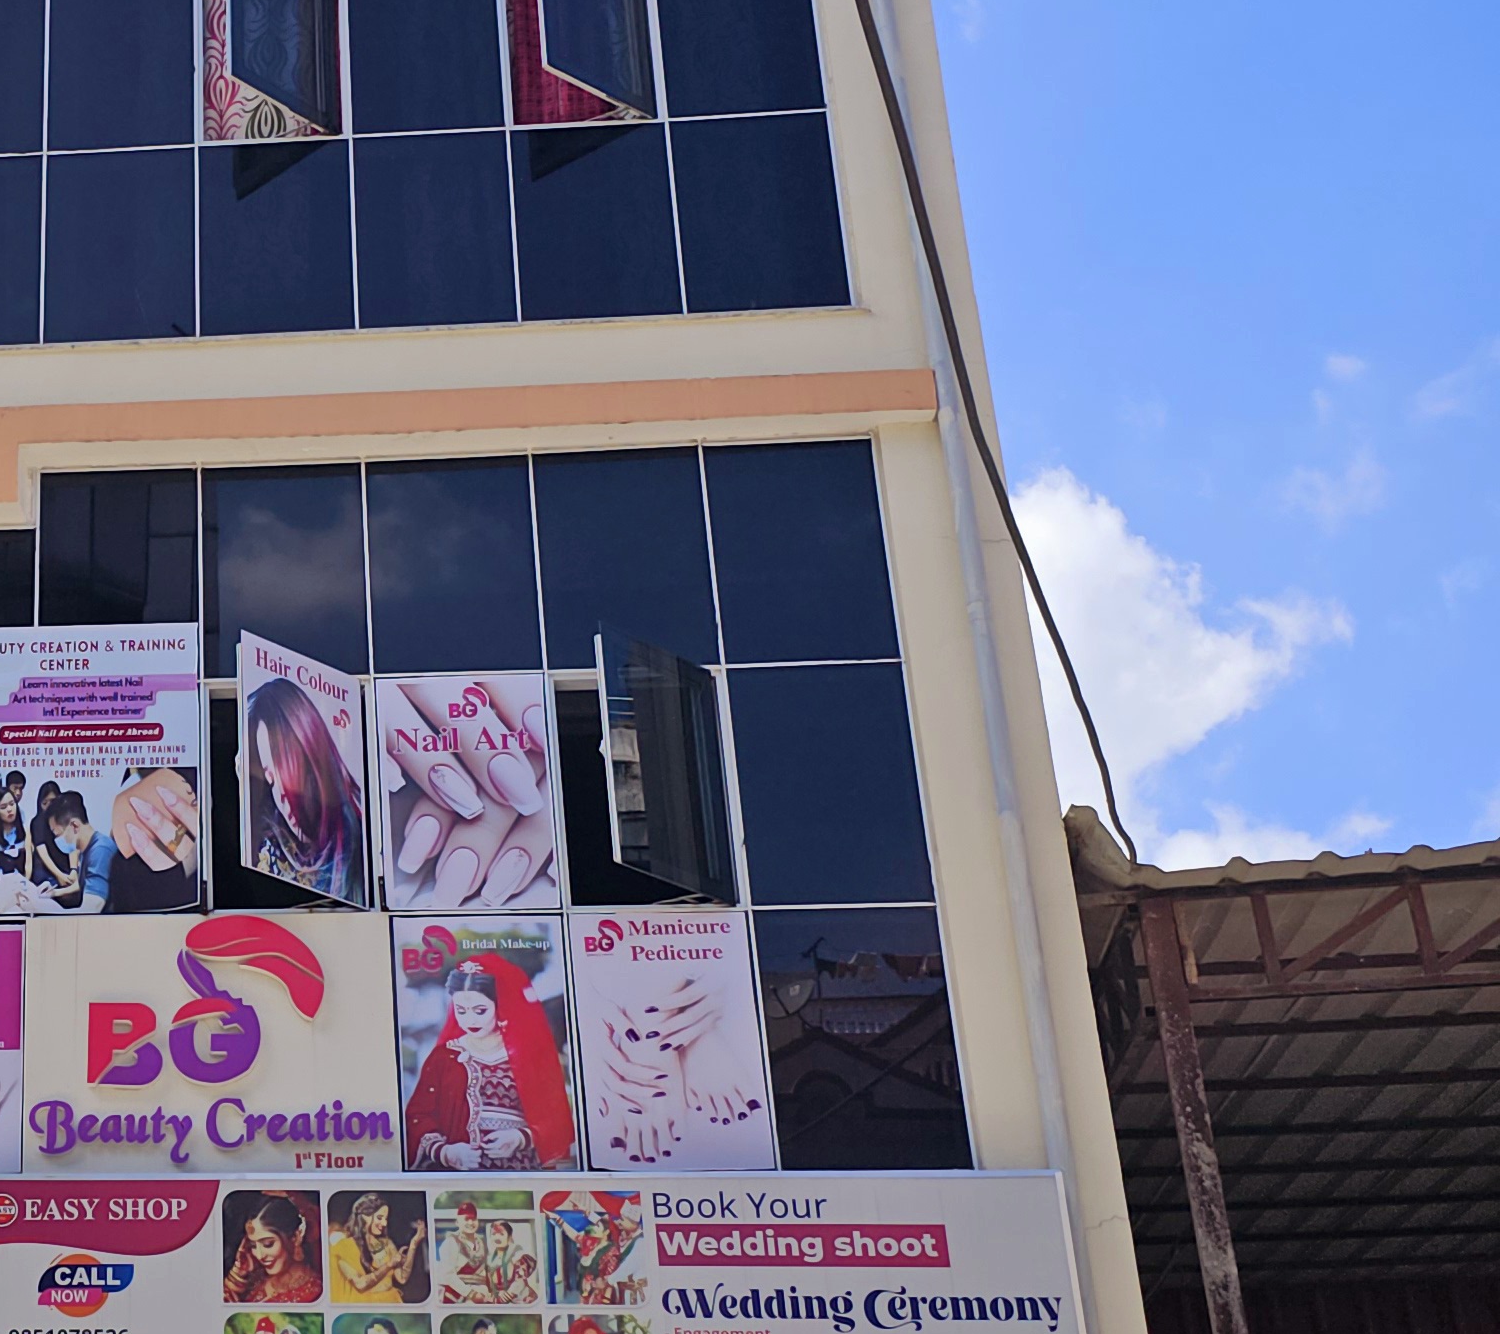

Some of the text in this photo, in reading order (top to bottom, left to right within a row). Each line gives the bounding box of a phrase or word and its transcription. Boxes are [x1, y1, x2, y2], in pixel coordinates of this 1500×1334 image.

[30, 640, 99, 654] CREATION
[120, 638, 186, 652] TRAINING
[39, 659, 90, 671] CENTER
[22, 676, 143, 689] Learn innovative latest Nail
[255, 646, 349, 703] Hair Colour
[12, 692, 153, 705] Art techniques with well trained
[61, 705, 142, 718] Experience trainer
[3, 727, 159, 739] Special Nail Art Course Abroad
[393, 726, 530, 753] Nail Art
[628, 919, 732, 938] Manicure
[462, 938, 550, 952] Bridal Make-up
[630, 944, 724, 962] Pedicure
[28, 1097, 394, 1164] Beauty Creation
[315, 1152, 364, 1168] Floor
[24, 1197, 188, 1221] EASY SHOP
[652, 1191, 827, 1219] Book Your
[658, 1229, 939, 1262] Wedding shoot
[54, 1267, 121, 1286] CALL
[51, 1290, 89, 1303] NOW
[661, 1282, 1062, 1333] Wedding Ceremony
